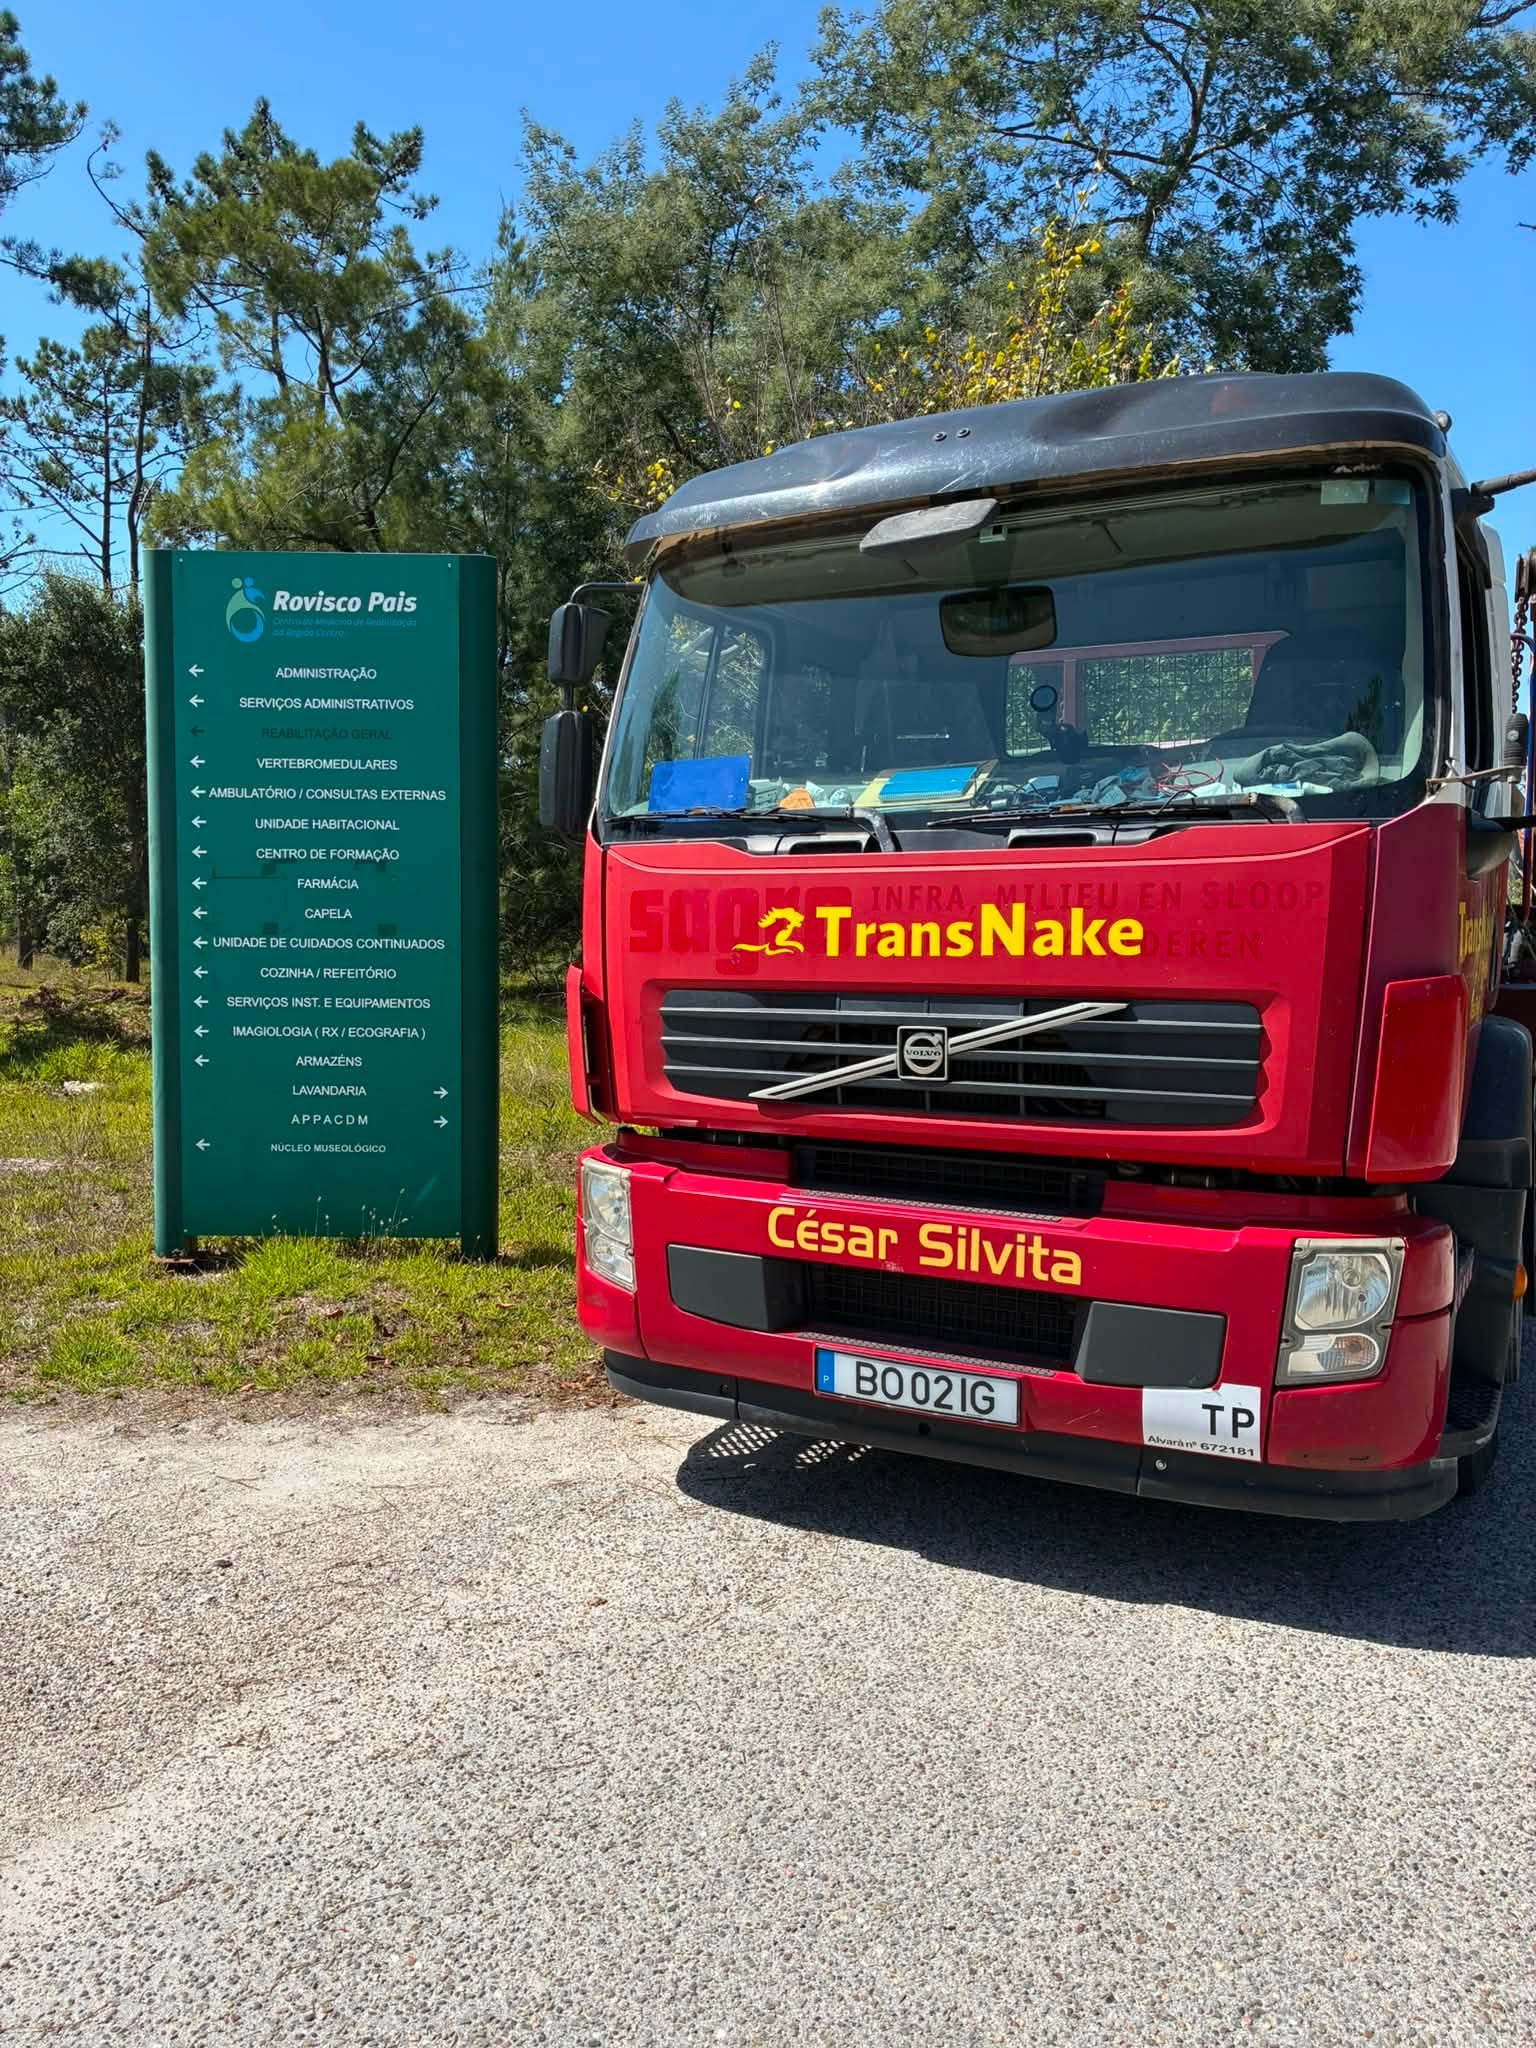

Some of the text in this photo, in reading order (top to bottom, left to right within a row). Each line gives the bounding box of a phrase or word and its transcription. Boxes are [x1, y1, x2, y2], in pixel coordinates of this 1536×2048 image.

[273, 590, 417, 612] Rovisco Pais
[275, 667, 377, 681] ADMINISTRAÇÃO
[239, 696, 414, 711] SERVIÇOS ADMINISTRATIVOS
[261, 726, 392, 741] REABILITAÇÃO GERAL
[256, 758, 398, 771] VERTEBROMEDULARES
[208, 785, 296, 800] AMBULATÓRIO
[305, 788, 378, 800] CONSULTAS
[381, 789, 446, 801] EXTERNAS
[255, 818, 400, 831] UNIDADE HABITACIONAL
[256, 848, 400, 863] CENTRO DE FORMAÇÃO
[297, 876, 359, 890] FARMÁCIA
[997, 883, 1119, 911] MILIEU
[1139, 881, 1183, 910] EN
[1203, 880, 1326, 911] SLOOP
[304, 907, 353, 919] CAPELA
[815, 902, 1144, 957] TransNake
[213, 936, 445, 950] UNIDADE DE CUIDADOS CONTINUADOS
[260, 967, 314, 979] COZINHA
[323, 966, 397, 980] REFEITÓRIO
[227, 996, 431, 1010] SERVIÇOS INST. E EQUIPAMENTOS
[232, 1025, 312, 1037] IMAGIOLOGIA
[321, 1026, 339, 1038] RX
[348, 1026, 419, 1038] ECOGRAFIA
[905, 1048, 942, 1058] VOLVO
[295, 1054, 363, 1067] ARMAZÉNS
[292, 1085, 367, 1097] LAVANDARIA
[270, 1142, 386, 1153] NÚCLEO MUSEOLÓGICO
[767, 1206, 1082, 1286] César Silvita
[822, 1374, 830, 1384] P
[1201, 1403, 1256, 1438] TP
[1200, 1442, 1255, 1457] 672181
